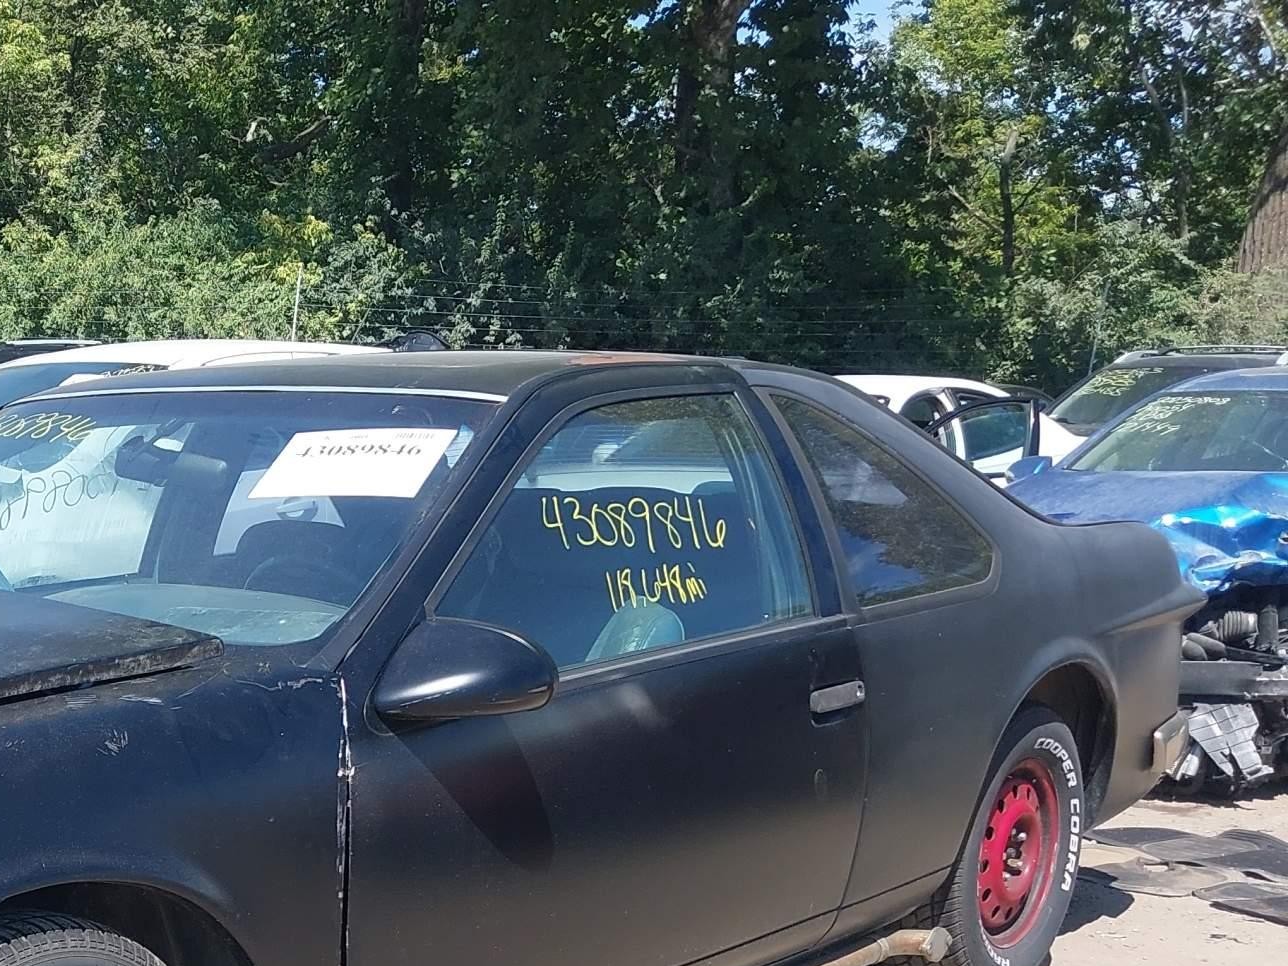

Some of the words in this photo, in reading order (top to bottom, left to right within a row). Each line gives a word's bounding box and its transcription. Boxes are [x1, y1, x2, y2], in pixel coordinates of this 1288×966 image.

[296, 443, 422, 458] 43089846
[541, 495, 727, 554] 43089846
[1033, 736, 1079, 789] COOPER
[1060, 798, 1080, 892] COBRA
